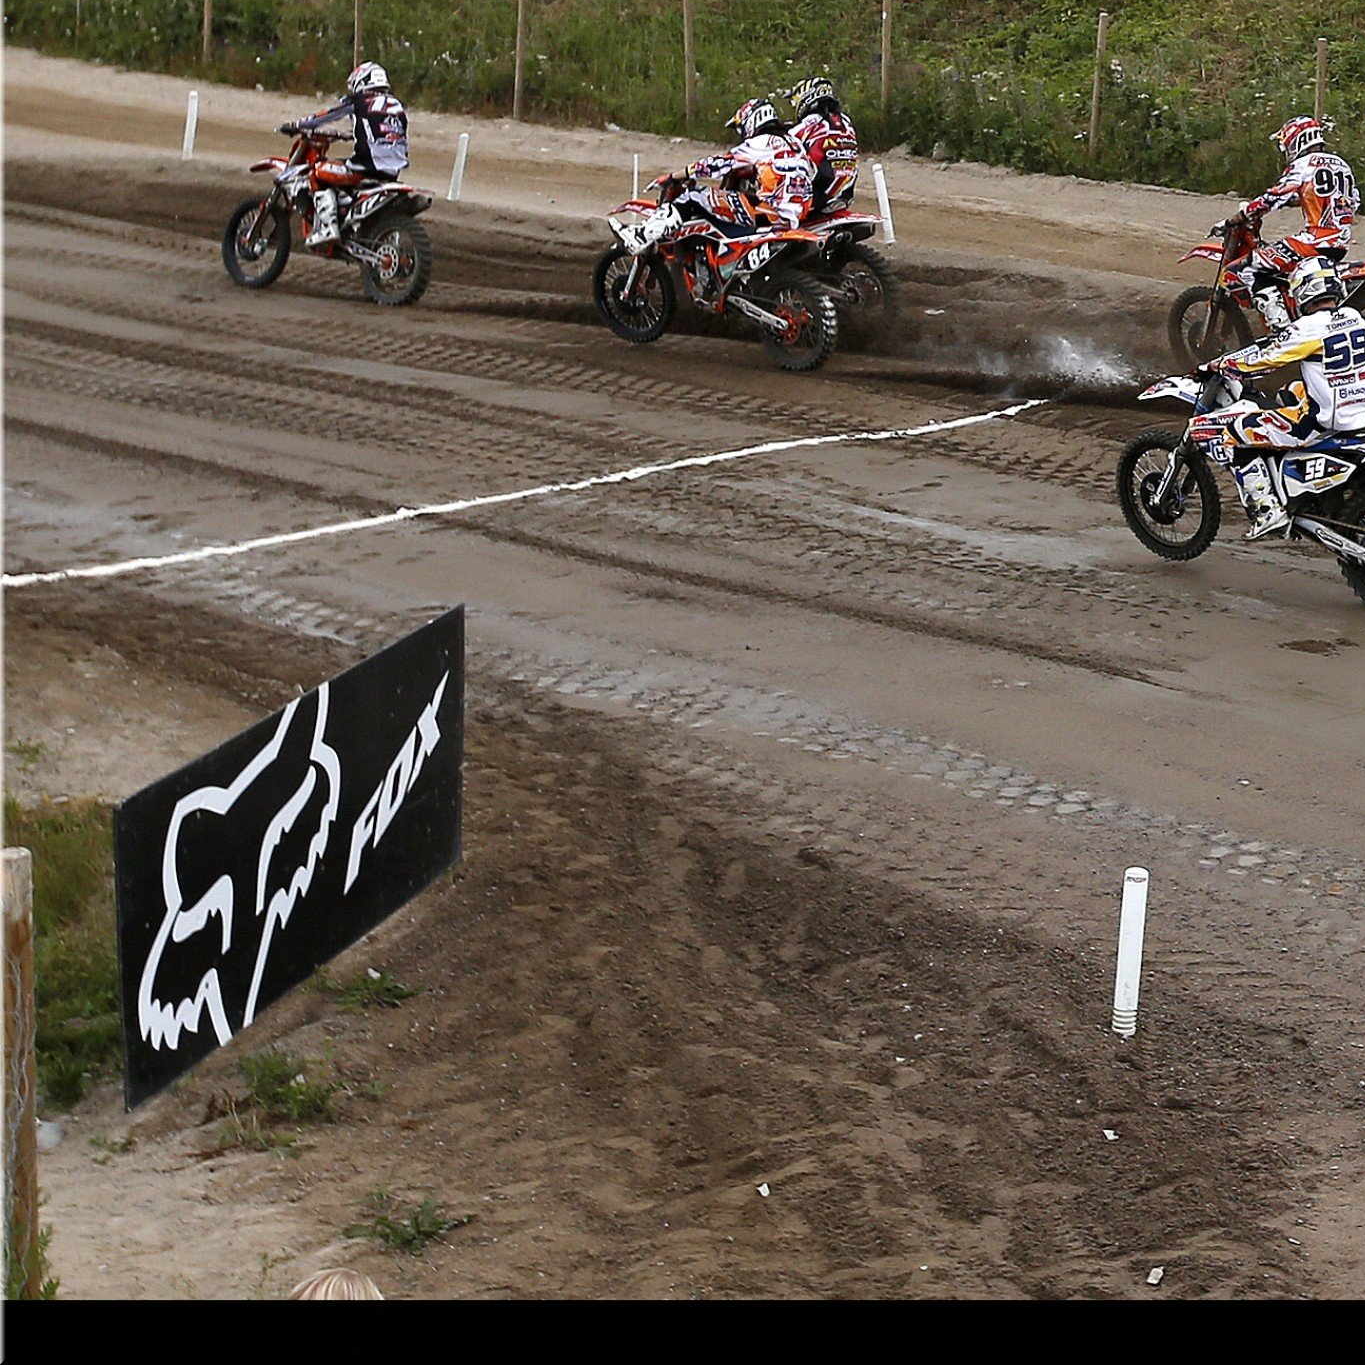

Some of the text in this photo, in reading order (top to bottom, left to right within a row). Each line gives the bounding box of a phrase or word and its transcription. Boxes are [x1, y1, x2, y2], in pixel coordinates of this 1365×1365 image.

[1314, 168, 1355, 197] 911
[747, 241, 771, 270] 84
[1325, 317, 1360, 332] TONKOV
[1304, 460, 1326, 480] 59
[344, 670, 450, 895] FOX
